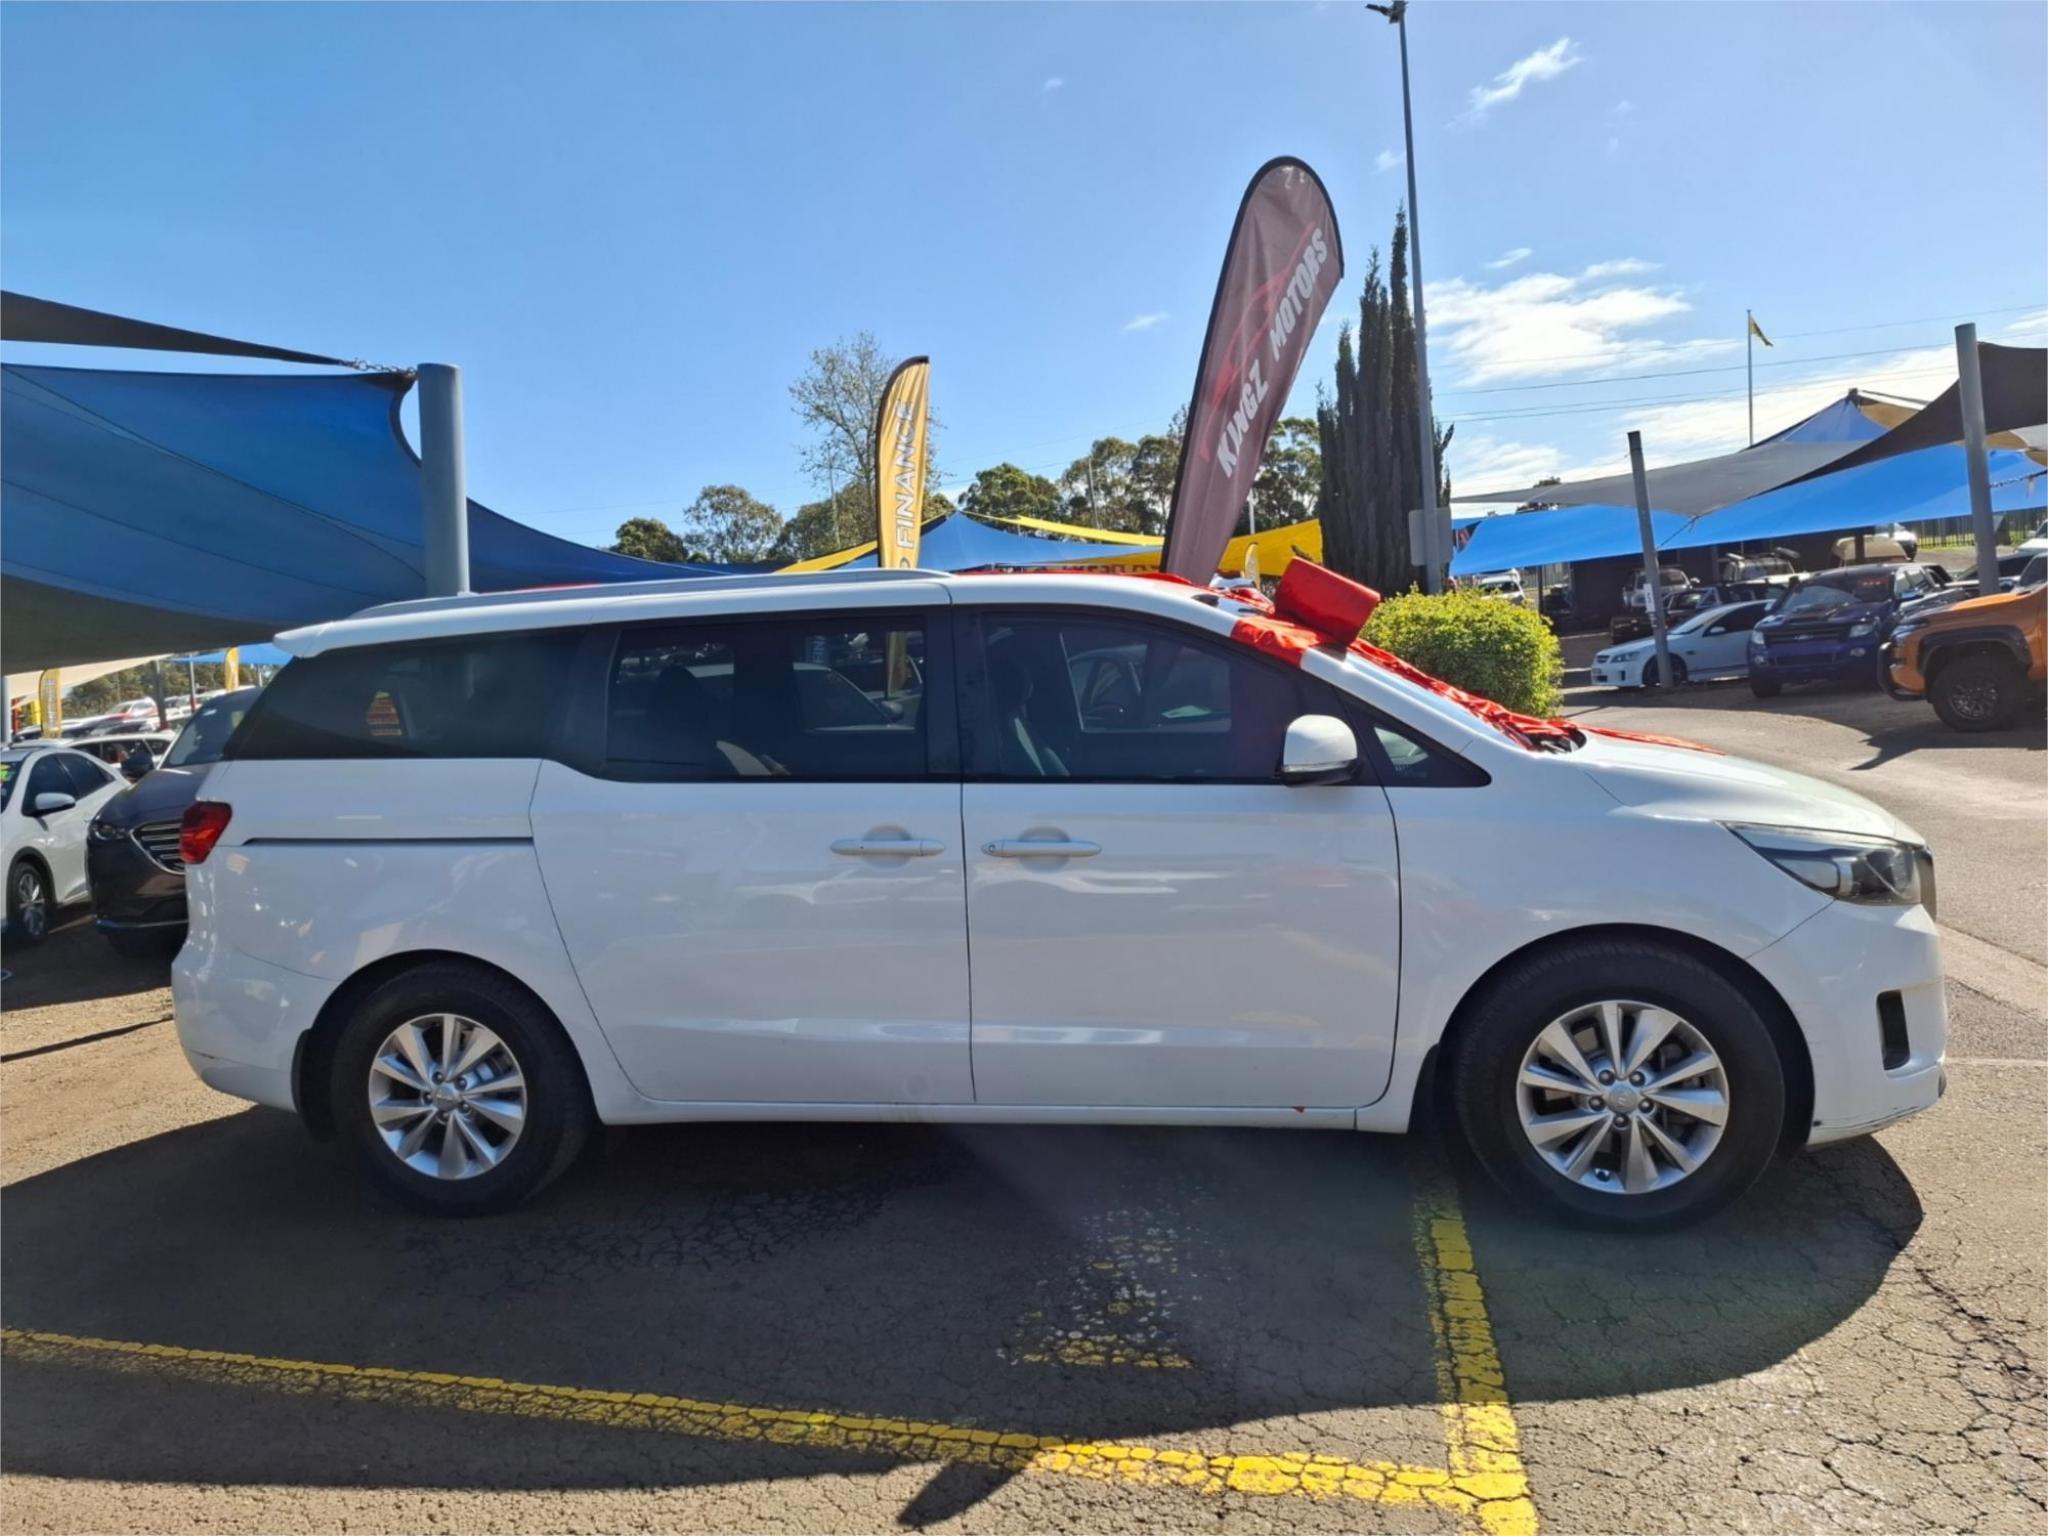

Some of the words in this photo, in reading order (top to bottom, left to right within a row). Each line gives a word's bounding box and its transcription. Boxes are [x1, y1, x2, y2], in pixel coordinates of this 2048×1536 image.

[1217, 358, 1269, 478] KINGZ
[1269, 227, 1327, 362] MOTORS
[895, 400, 916, 549] FINANCE
